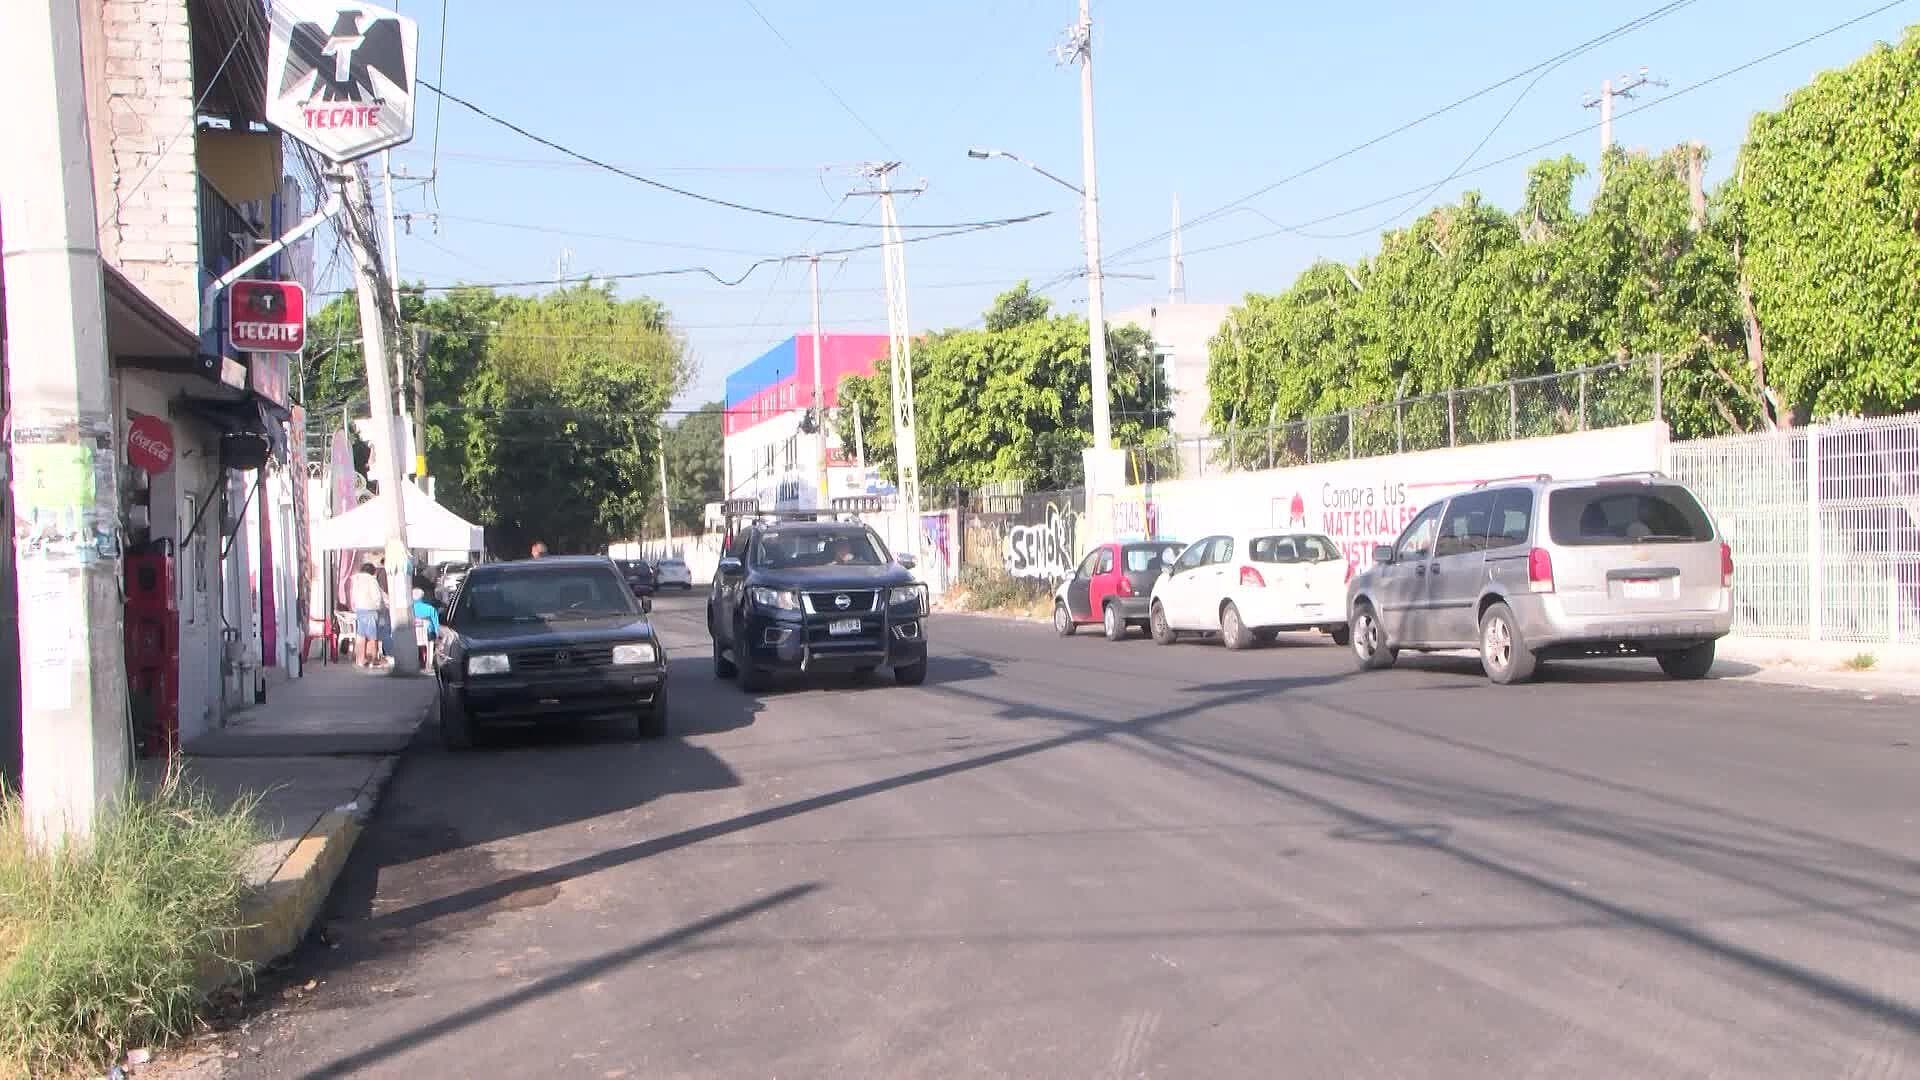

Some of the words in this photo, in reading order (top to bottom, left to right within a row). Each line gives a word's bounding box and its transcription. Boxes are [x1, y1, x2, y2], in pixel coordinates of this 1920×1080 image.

[321, 35, 366, 82] T
[303, 105, 381, 130] TECATE
[234, 321, 300, 342] TECATE
[1322, 481, 1374, 511] Compra
[1383, 479, 1406, 506] tus
